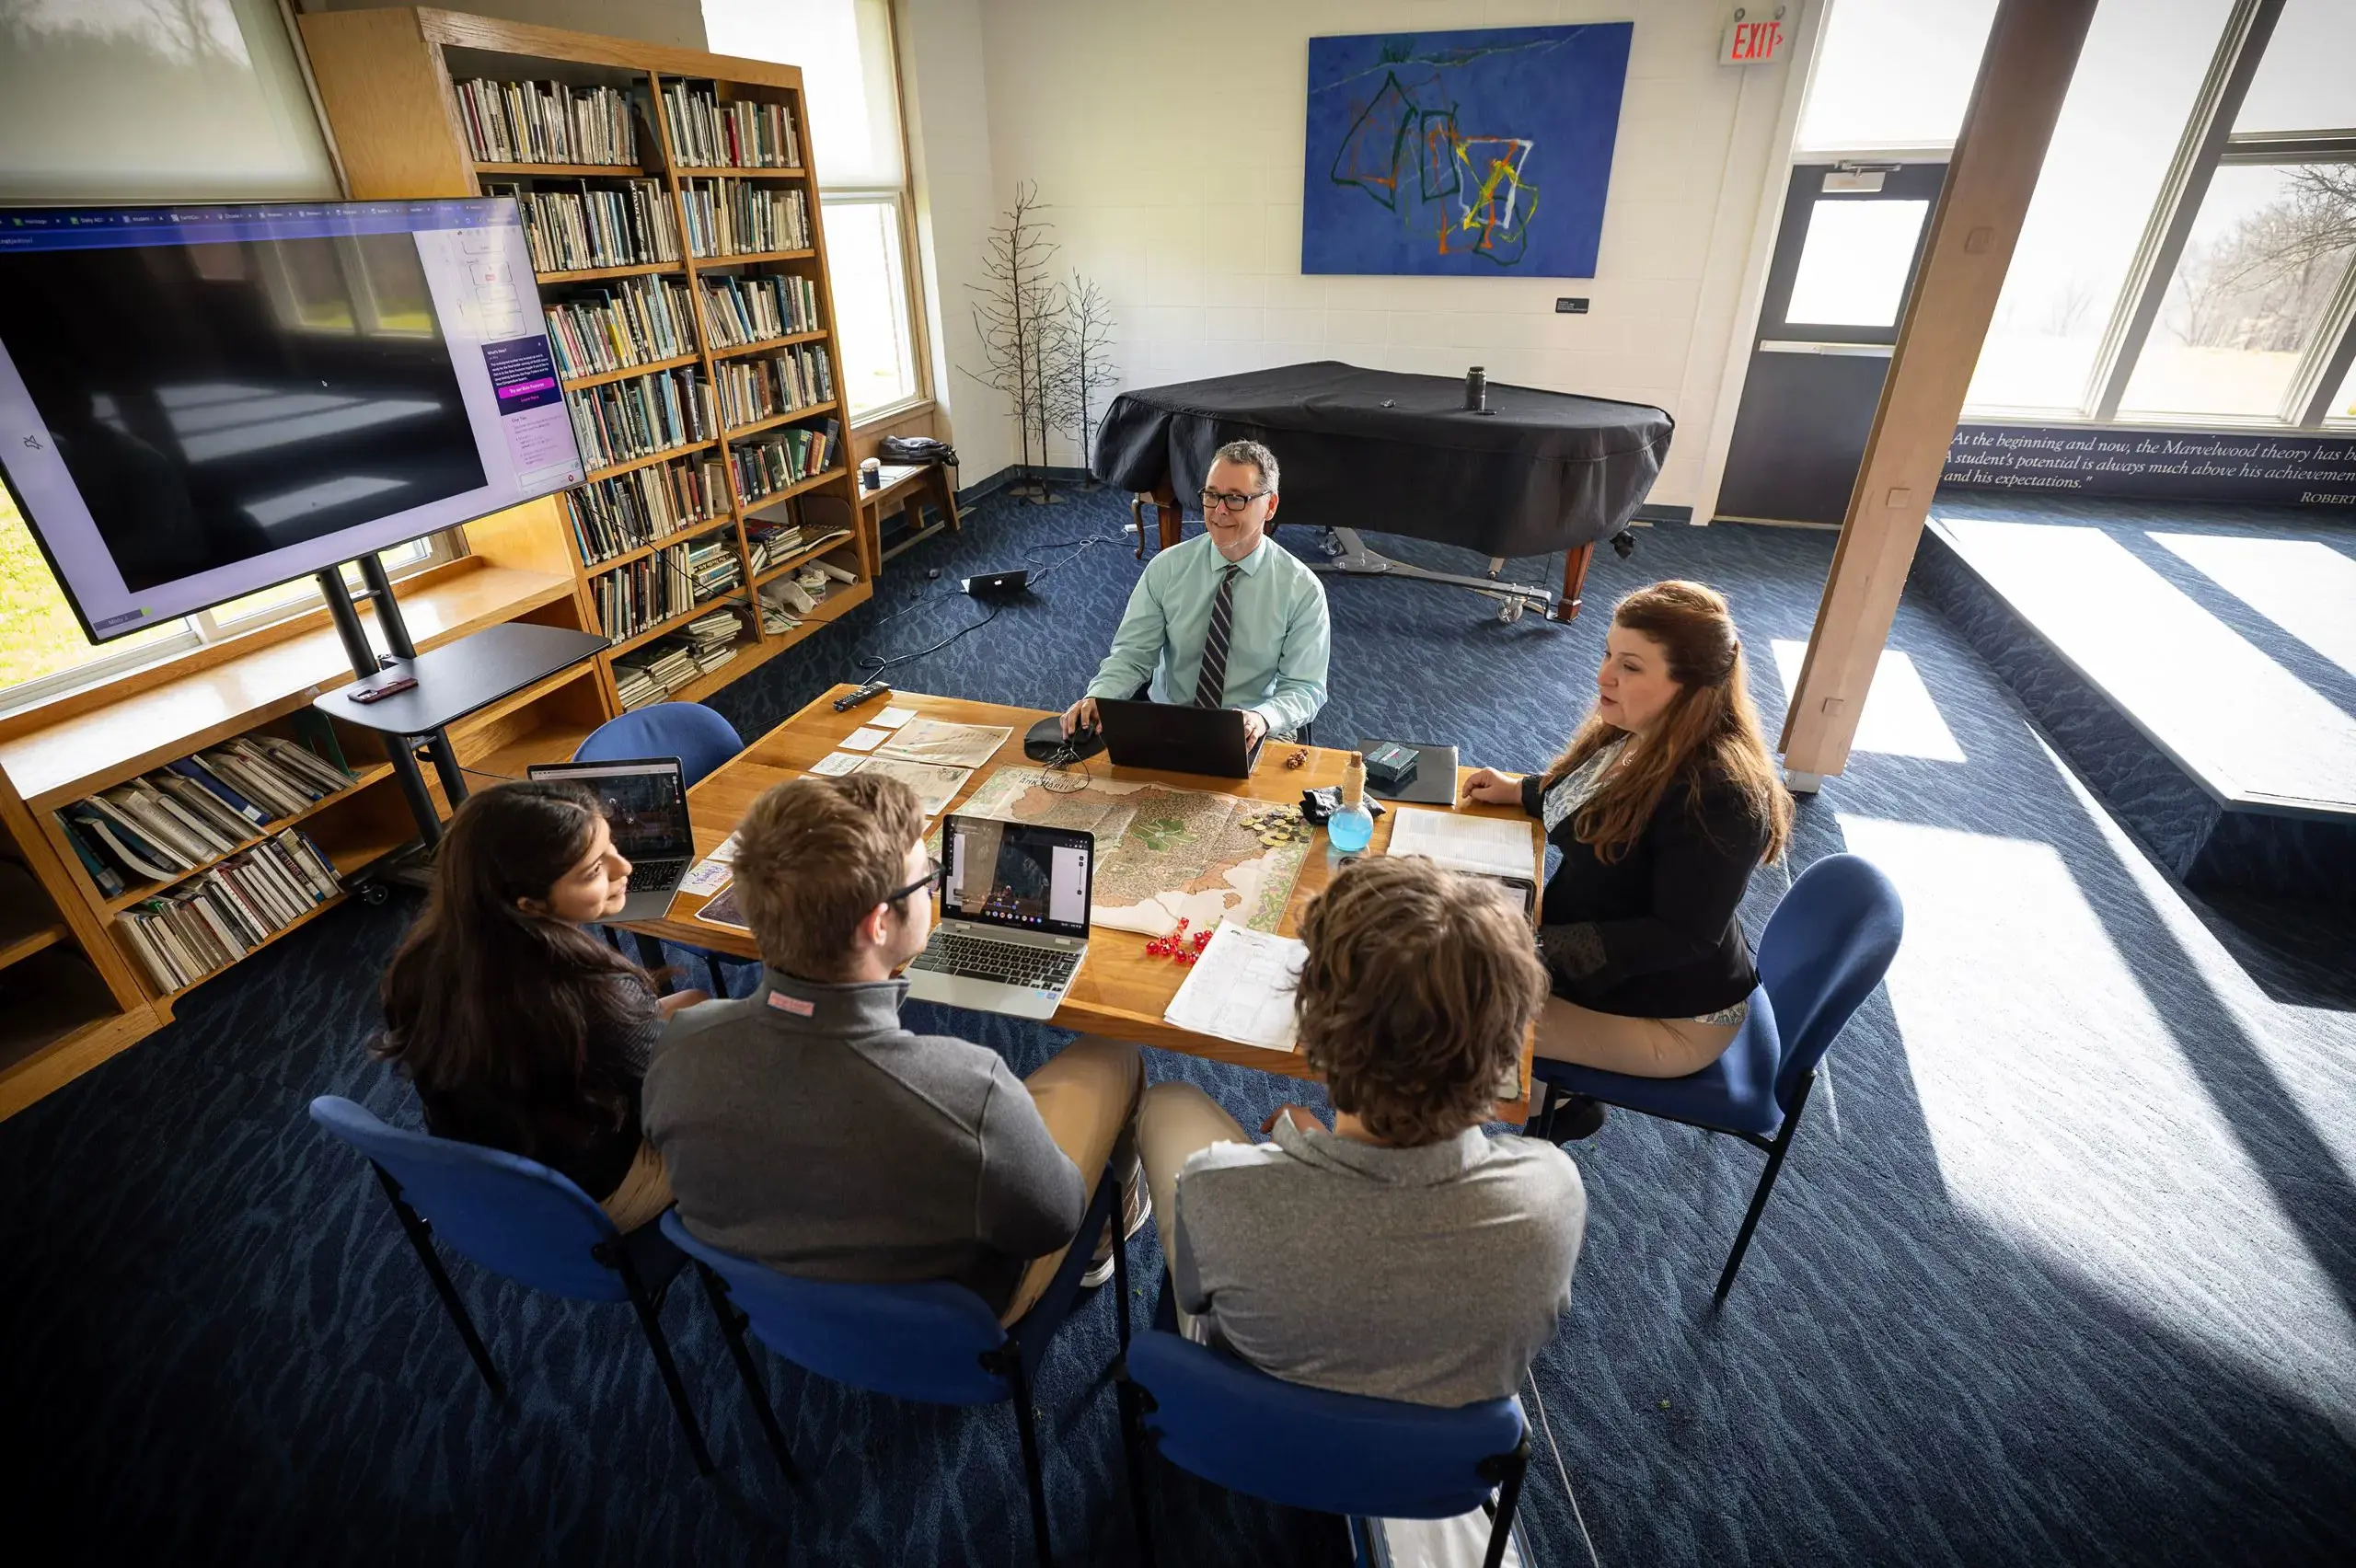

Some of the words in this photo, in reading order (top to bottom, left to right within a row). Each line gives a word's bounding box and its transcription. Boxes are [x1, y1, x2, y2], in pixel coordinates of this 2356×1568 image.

[1732, 22, 1780, 59] EXIT
[1951, 432, 1971, 445] At
[1972, 432, 1994, 446] the
[1996, 432, 2063, 452] beginning
[2065, 436, 2097, 451] and
[2098, 441, 2131, 455] now,
[2135, 438, 2160, 454] the
[2162, 440, 2260, 457] Marvelwood
[2261, 444, 2310, 463] theory
[2313, 445, 2341, 461] has
[1944, 468, 1972, 482] and
[1973, 469, 1993, 484] his
[1955, 451, 2015, 466] student's
[2015, 455, 2082, 469] potential
[2082, 457, 2094, 470] is
[2096, 456, 2146, 475] always
[2148, 460, 2189, 475] much
[2191, 462, 2236, 477] above
[2238, 462, 2263, 478] his
[2300, 491, 2356, 505] ROBERT
